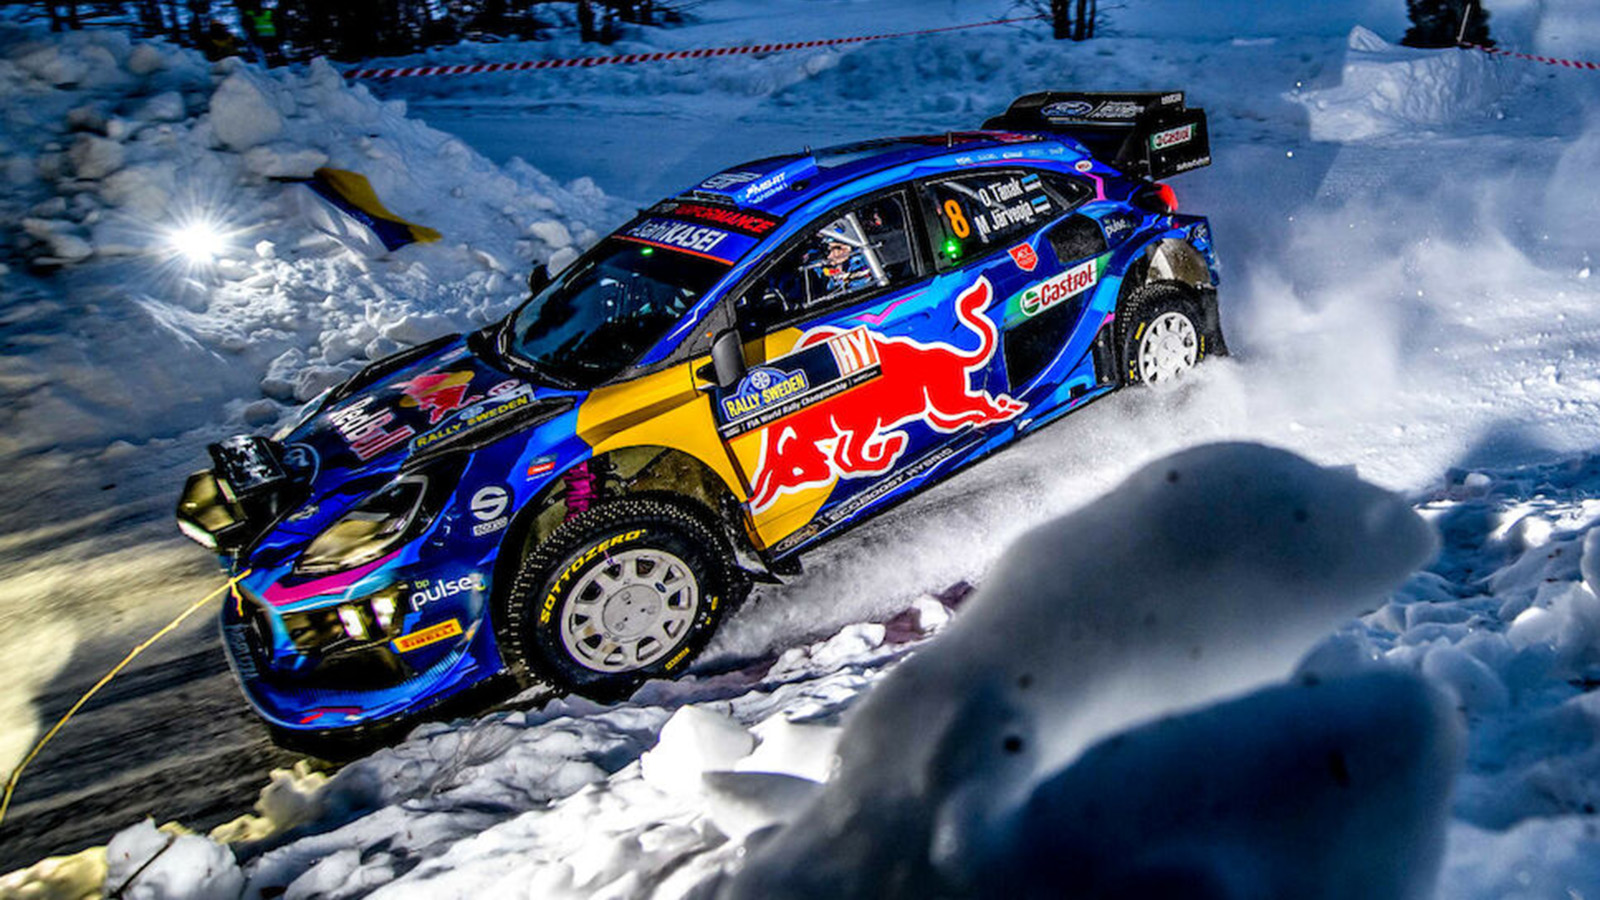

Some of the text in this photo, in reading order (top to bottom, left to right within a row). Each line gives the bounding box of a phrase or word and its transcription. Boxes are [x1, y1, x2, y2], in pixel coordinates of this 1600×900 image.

[944, 199, 970, 239] 8
[1040, 264, 1093, 307] Castrol
[833, 328, 872, 375] HY
[726, 373, 805, 418] RALLY SWEDEN
[417, 395, 528, 448] RALLY SWEDEN
[829, 447, 954, 522] ECOBOOST HYBRID
[411, 576, 472, 612] pulse
[415, 578, 430, 590] bp
[540, 529, 642, 624] SOTTOZERO
[399, 623, 456, 649] PIRELLI
